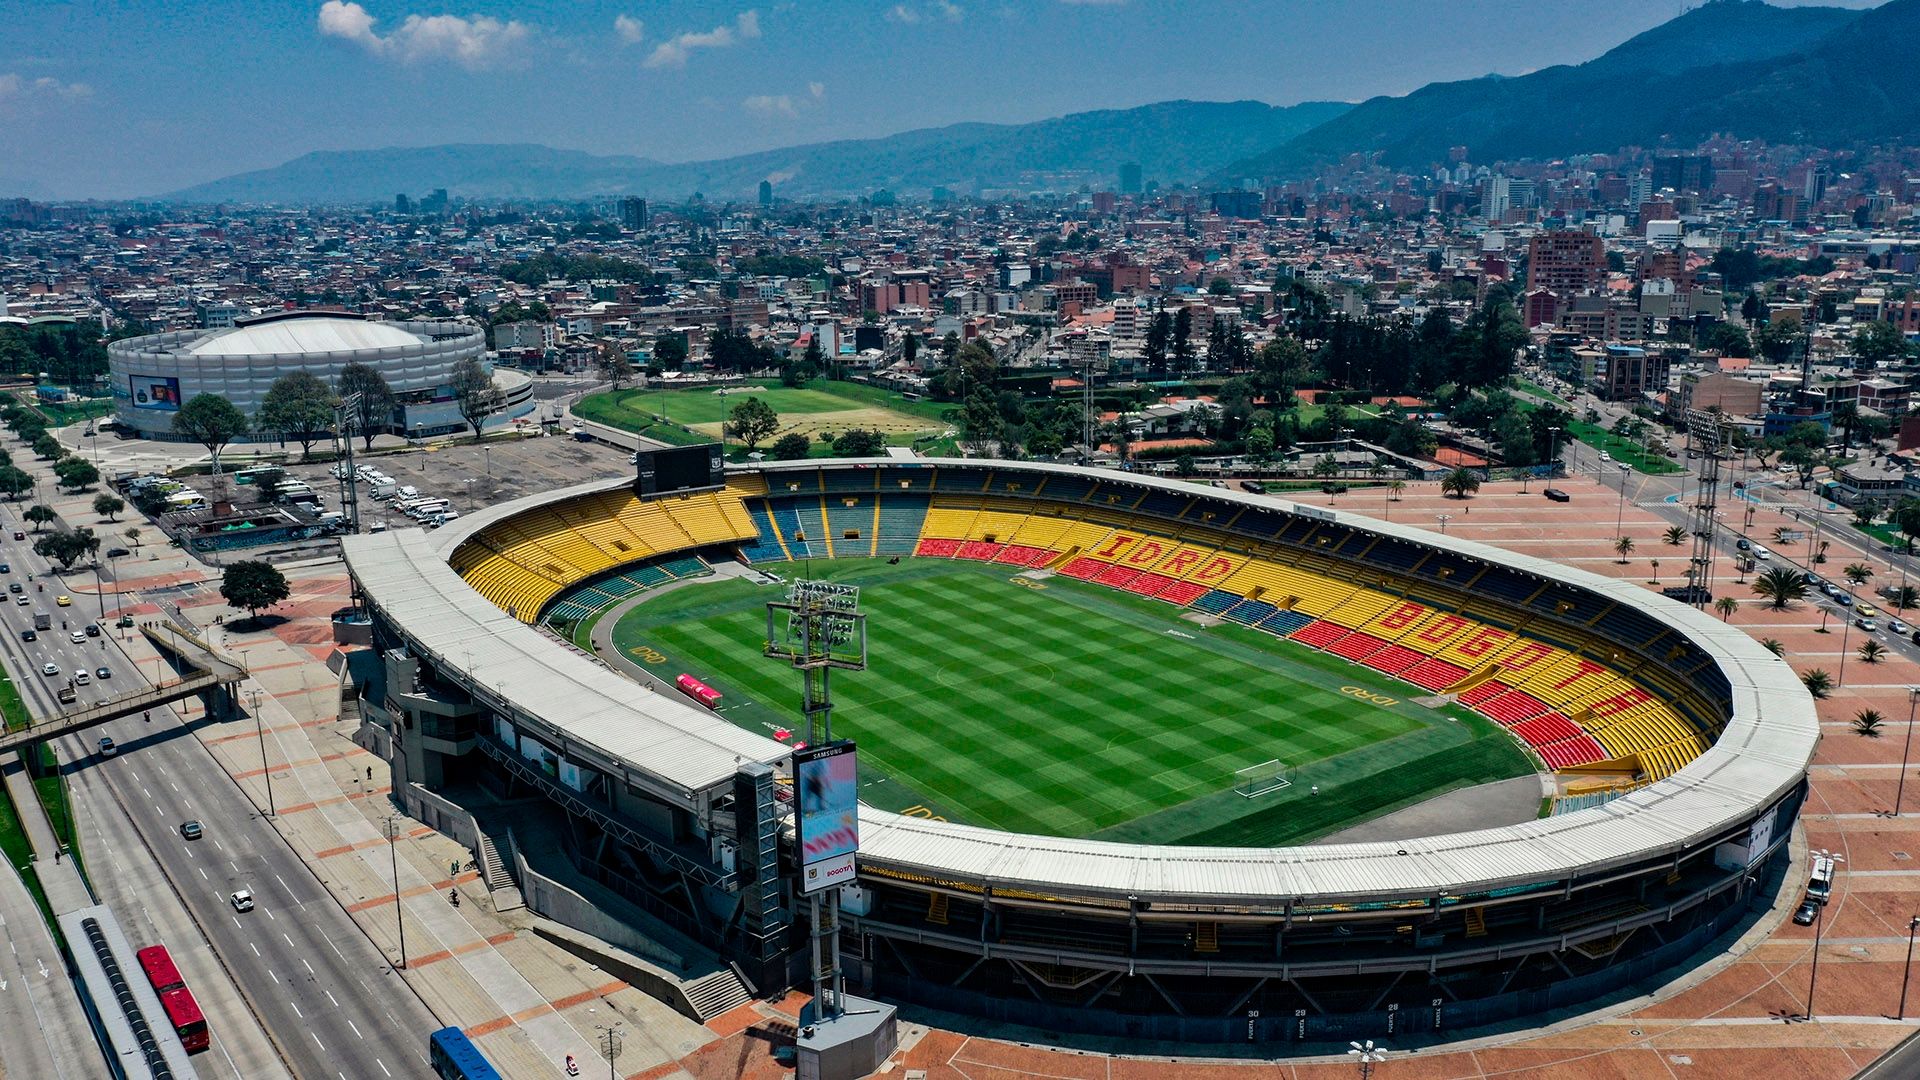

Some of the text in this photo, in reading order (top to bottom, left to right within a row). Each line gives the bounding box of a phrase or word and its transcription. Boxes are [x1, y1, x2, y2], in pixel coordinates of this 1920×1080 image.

[1097, 535, 1233, 580] IDRD
[1341, 685, 1400, 707] IDRD
[813, 748, 843, 759] SAMSUNG
[1432, 998, 1443, 1006] 27
[1388, 1003, 1399, 1011] 28
[1248, 1010, 1259, 1018] 30
[1295, 1009, 1306, 1017] 29
